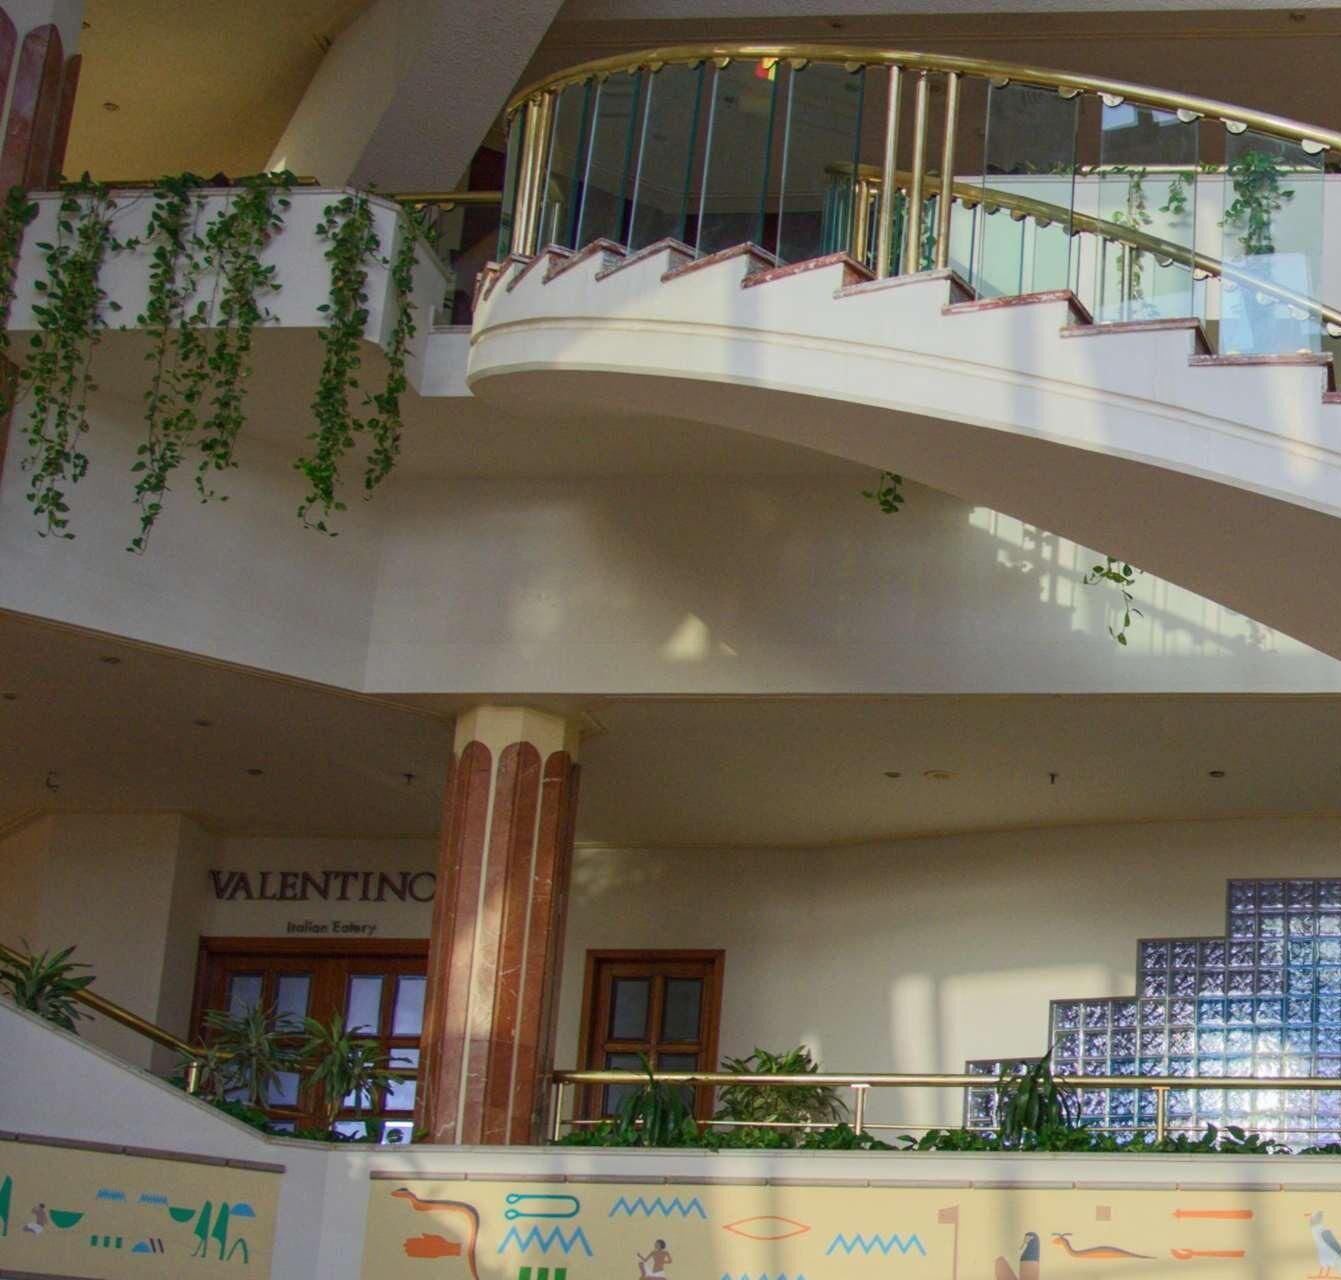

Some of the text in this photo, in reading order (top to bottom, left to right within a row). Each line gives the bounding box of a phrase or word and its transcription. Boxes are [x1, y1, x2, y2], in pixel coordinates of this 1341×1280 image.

[209, 870, 437, 902] VALENTINO
[286, 921, 377, 935] Italian Eatery
